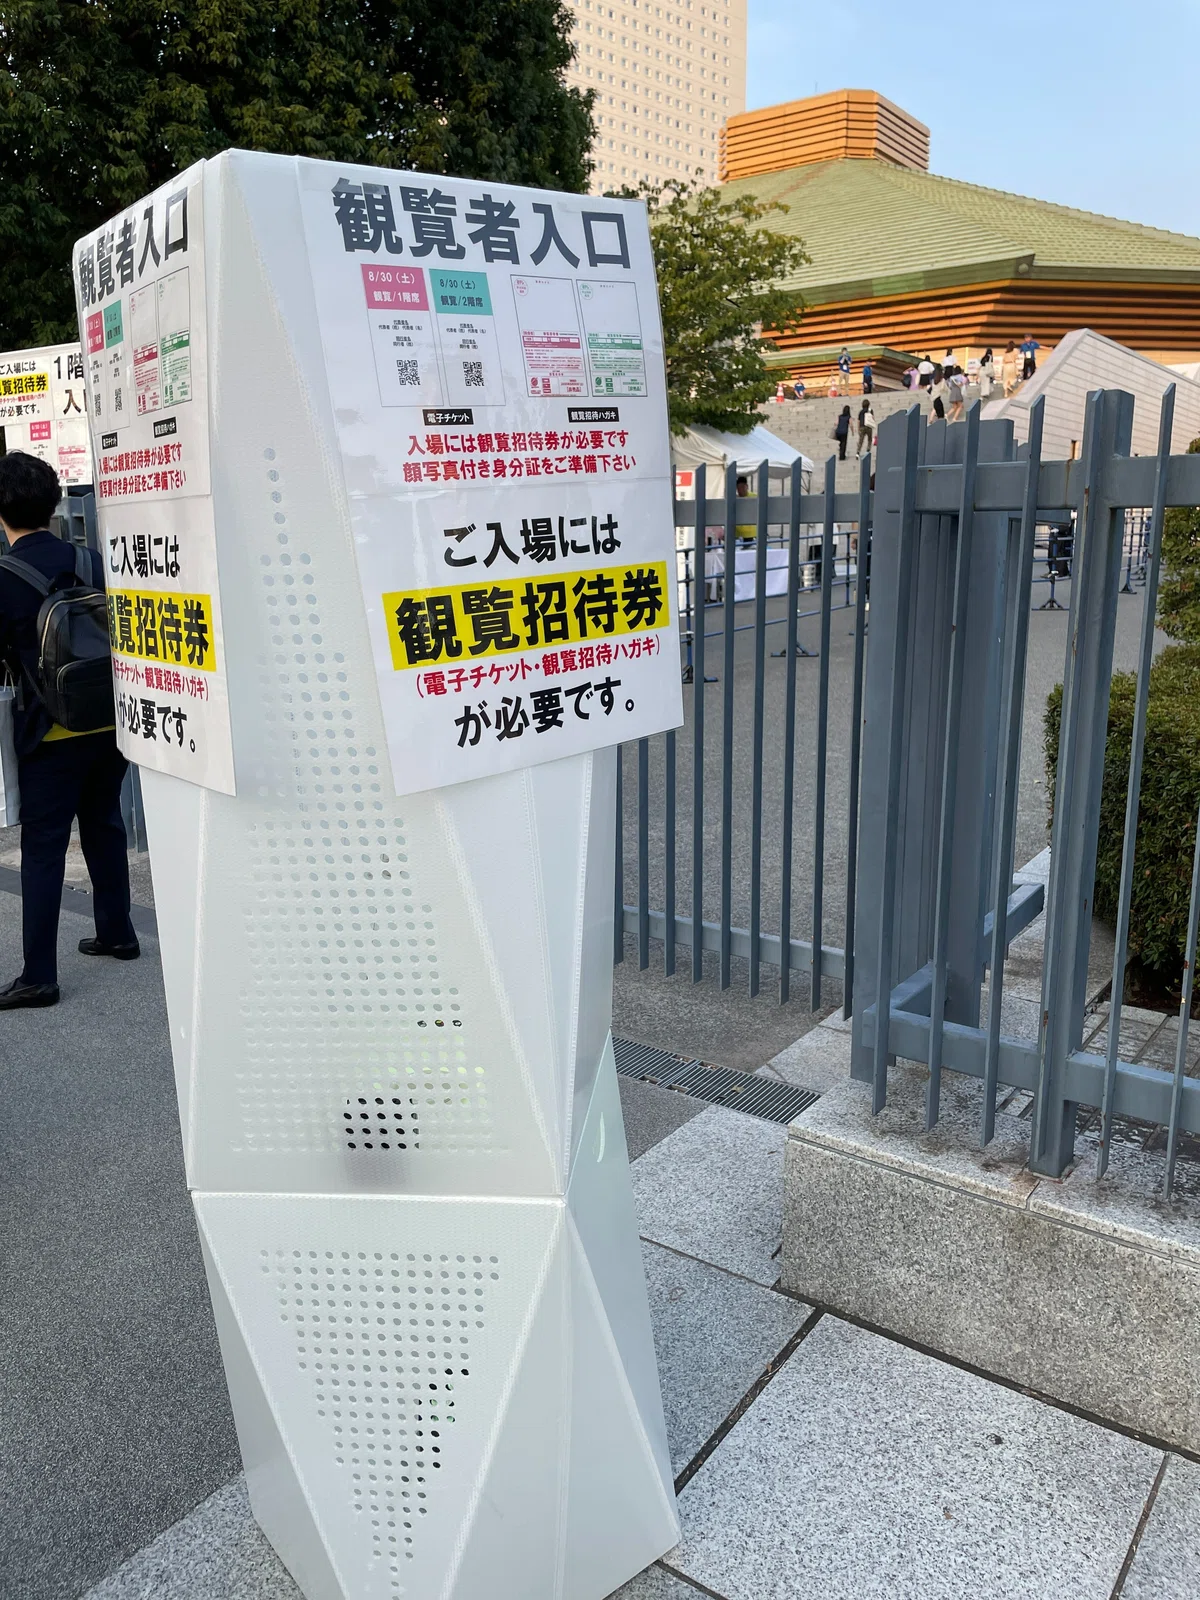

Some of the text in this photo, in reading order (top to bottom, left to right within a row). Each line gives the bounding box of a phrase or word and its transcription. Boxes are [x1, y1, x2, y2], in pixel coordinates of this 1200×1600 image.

[331, 178, 631, 269] 観覧者入口
[79, 186, 188, 312] 観覧者入口
[0, 375, 47, 397] 覧招待券
[426, 412, 470, 423] 電子チケット
[570, 410, 616, 421] 観覧招待ハガキ
[407, 430, 629, 456] 入場には観覧招待券が必要です
[402, 454, 637, 482] 顔写真付き身分証をご準備下さい
[109, 533, 181, 578] ご入場には
[443, 514, 622, 568] ご入場には
[395, 568, 663, 665] 観覧招待券
[454, 676, 635, 748] が必要です。
